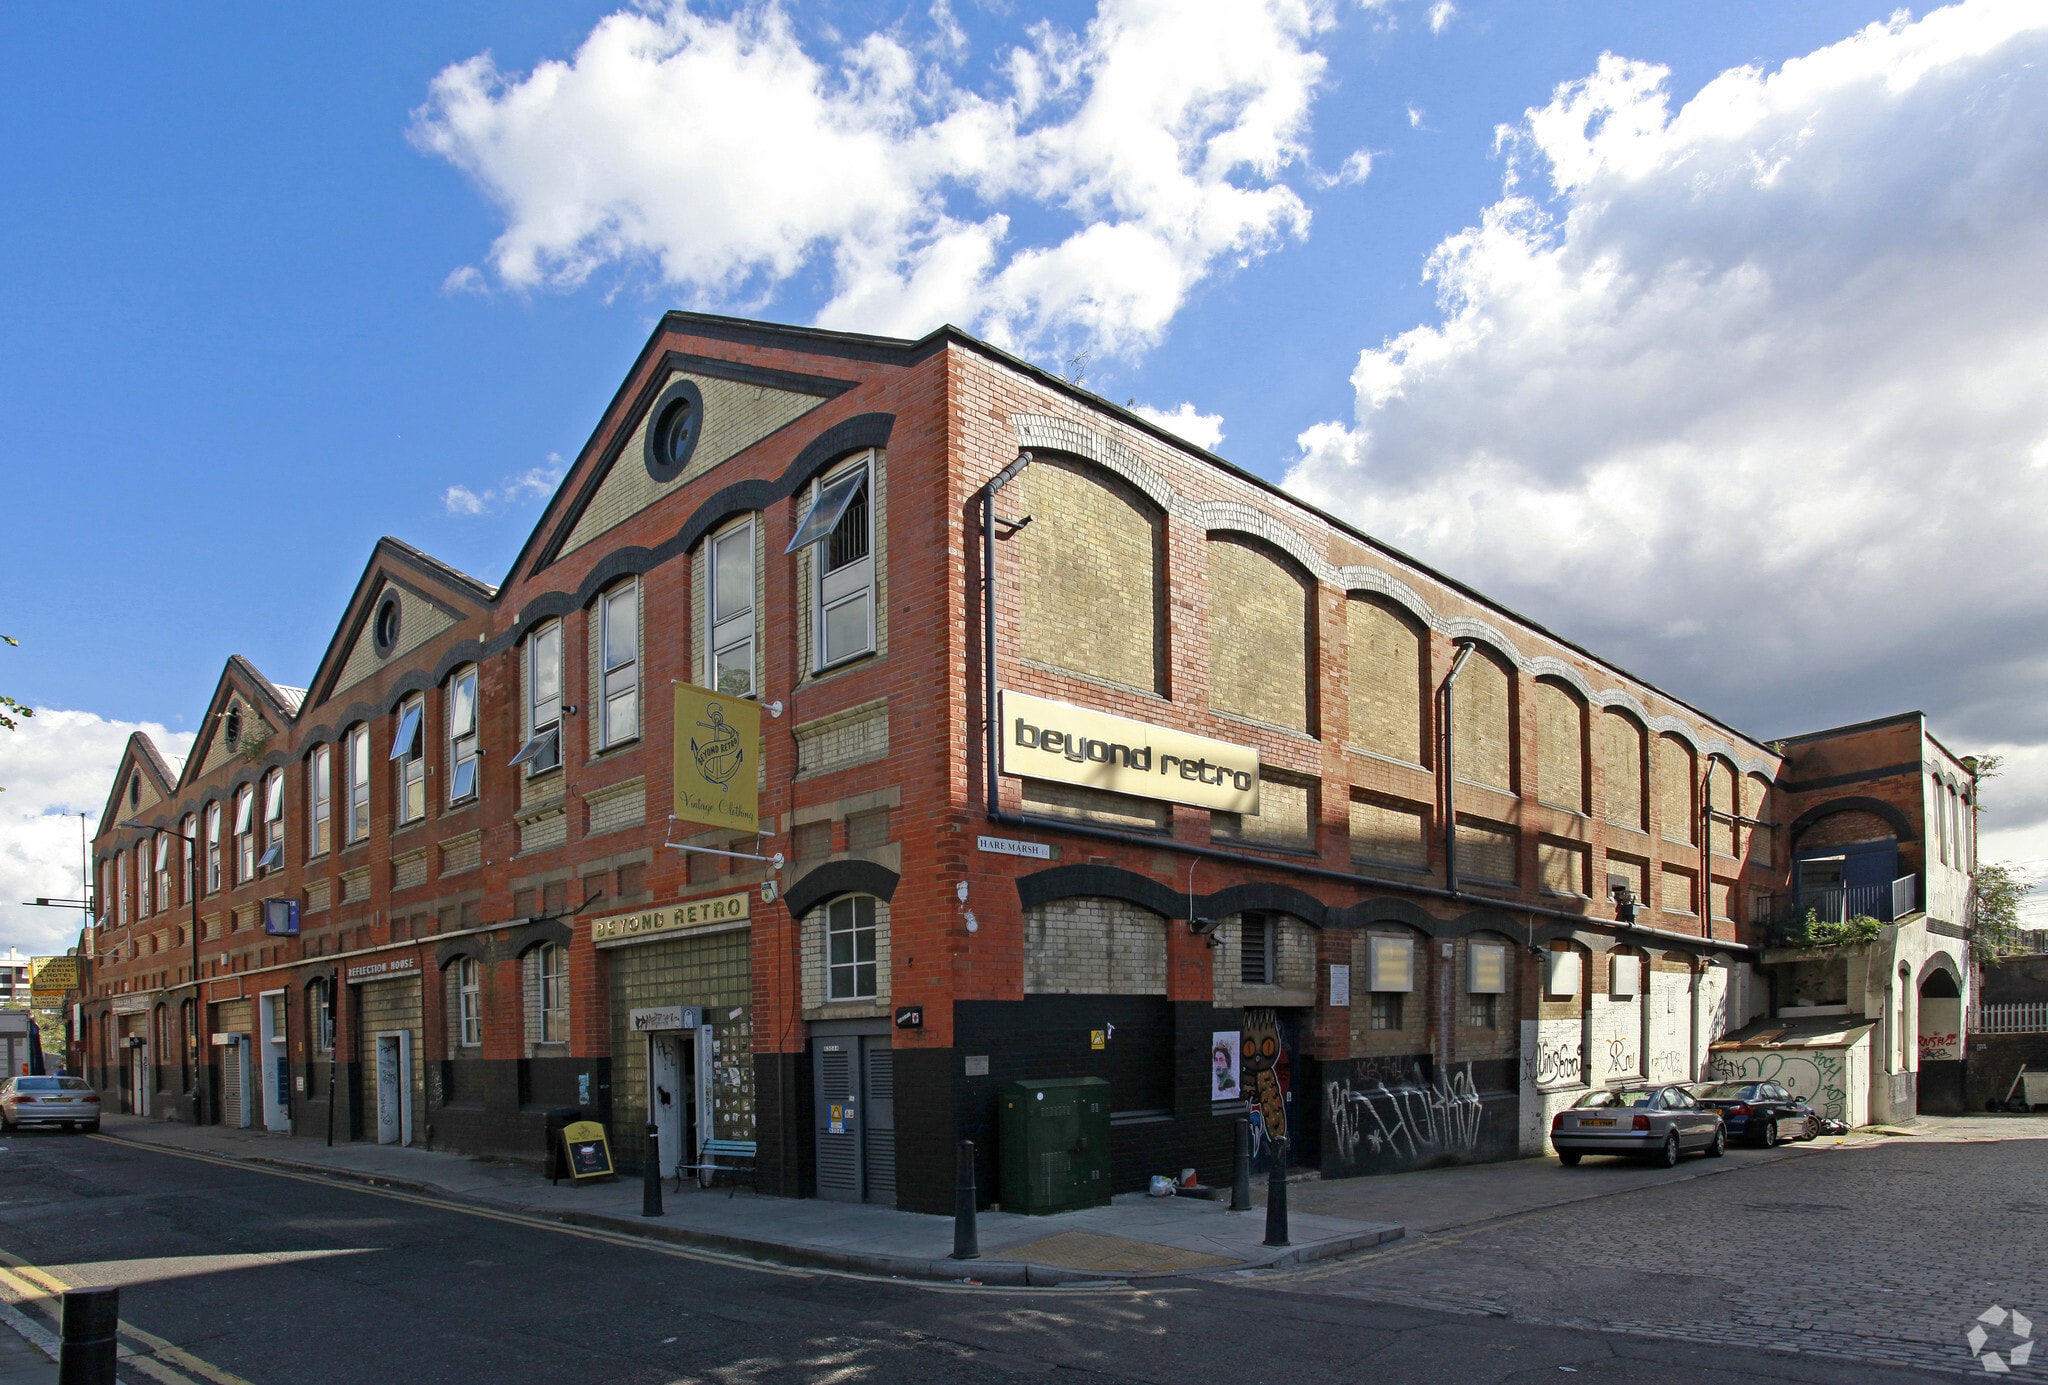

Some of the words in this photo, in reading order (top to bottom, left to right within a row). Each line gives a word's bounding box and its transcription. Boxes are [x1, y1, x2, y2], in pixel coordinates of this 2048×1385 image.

[698, 744, 719, 766] BEYOND
[720, 737, 738, 752] RETRO
[1015, 717, 1152, 772] beyond
[1160, 752, 1252, 792] retro
[680, 790, 714, 815] Vintage
[718, 798, 755, 821] Clothing
[980, 839, 1006, 850] HARE
[1007, 842, 1039, 855] MARSH
[596, 912, 665, 938] BEYOND
[673, 898, 741, 925] RETRO
[348, 962, 387, 977] REFLECTION
[390, 958, 415, 970] HOUSE
